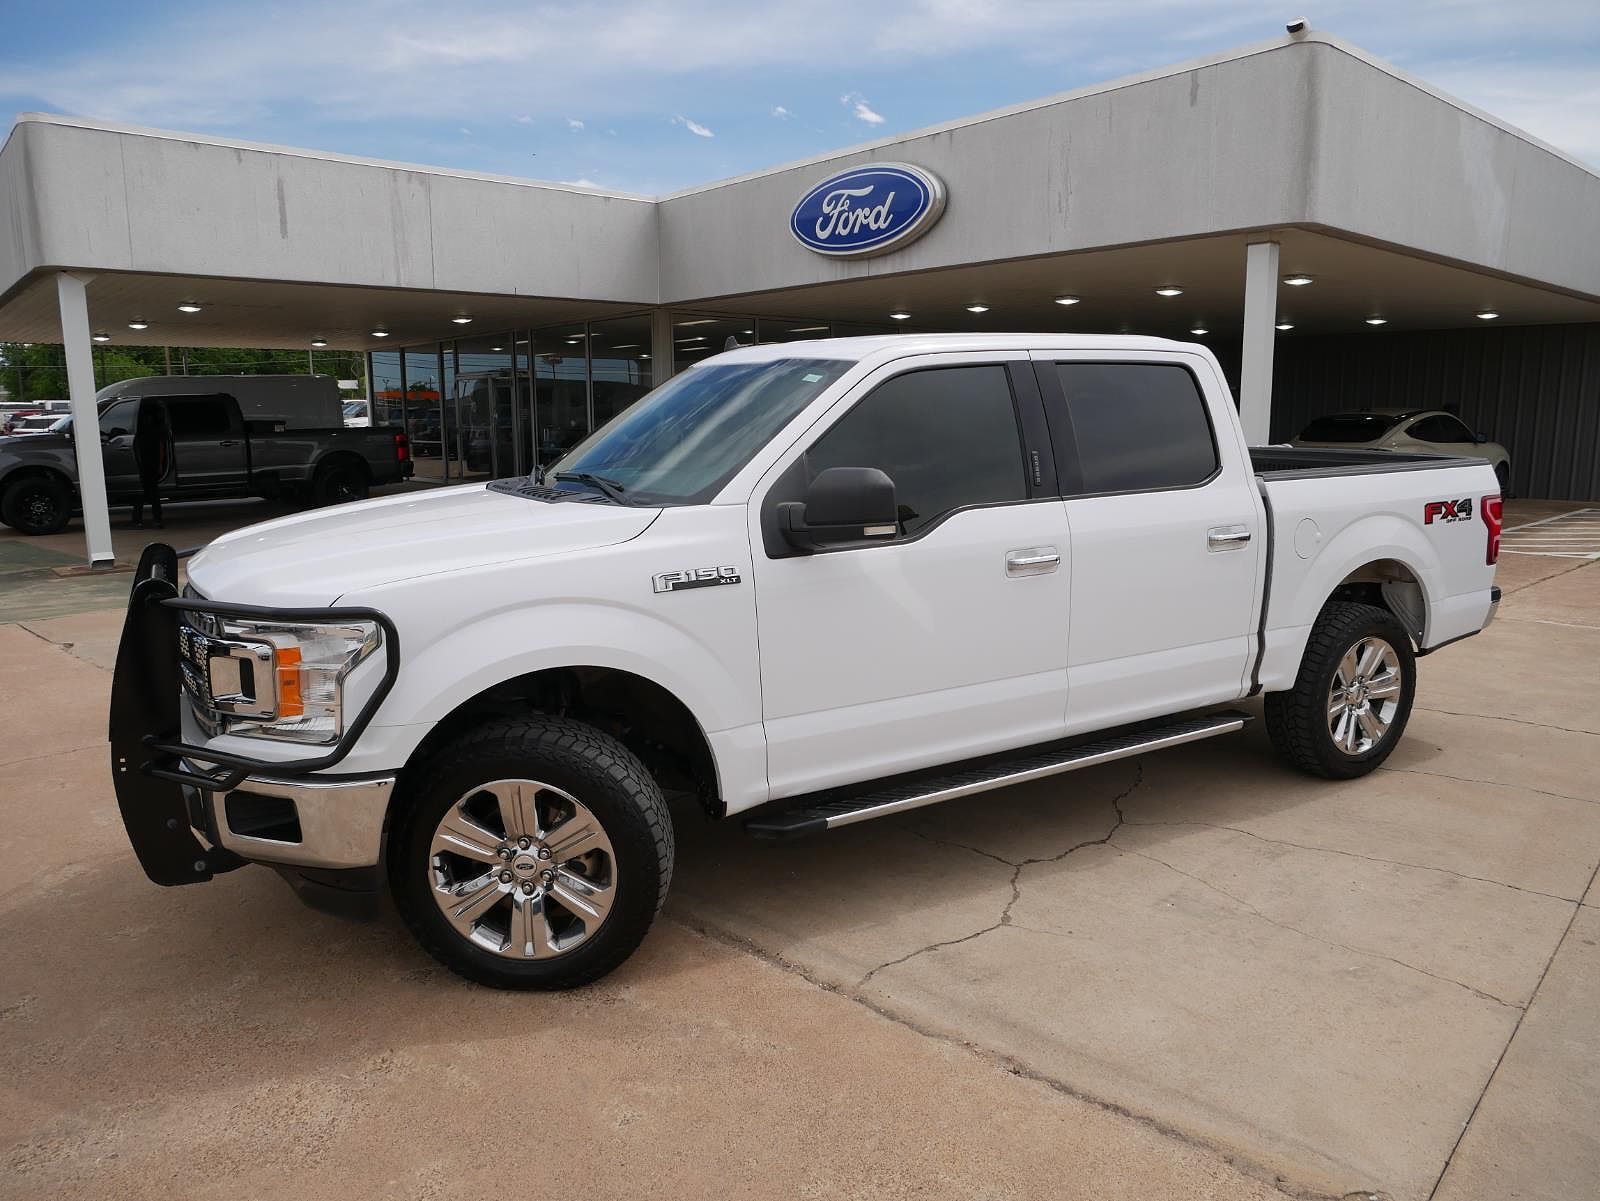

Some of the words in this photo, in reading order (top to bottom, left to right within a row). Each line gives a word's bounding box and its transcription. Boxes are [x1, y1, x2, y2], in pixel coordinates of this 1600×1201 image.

[815, 185, 895, 240] Ford
[1424, 498, 1472, 525] FX4
[652, 566, 739, 593] F150
